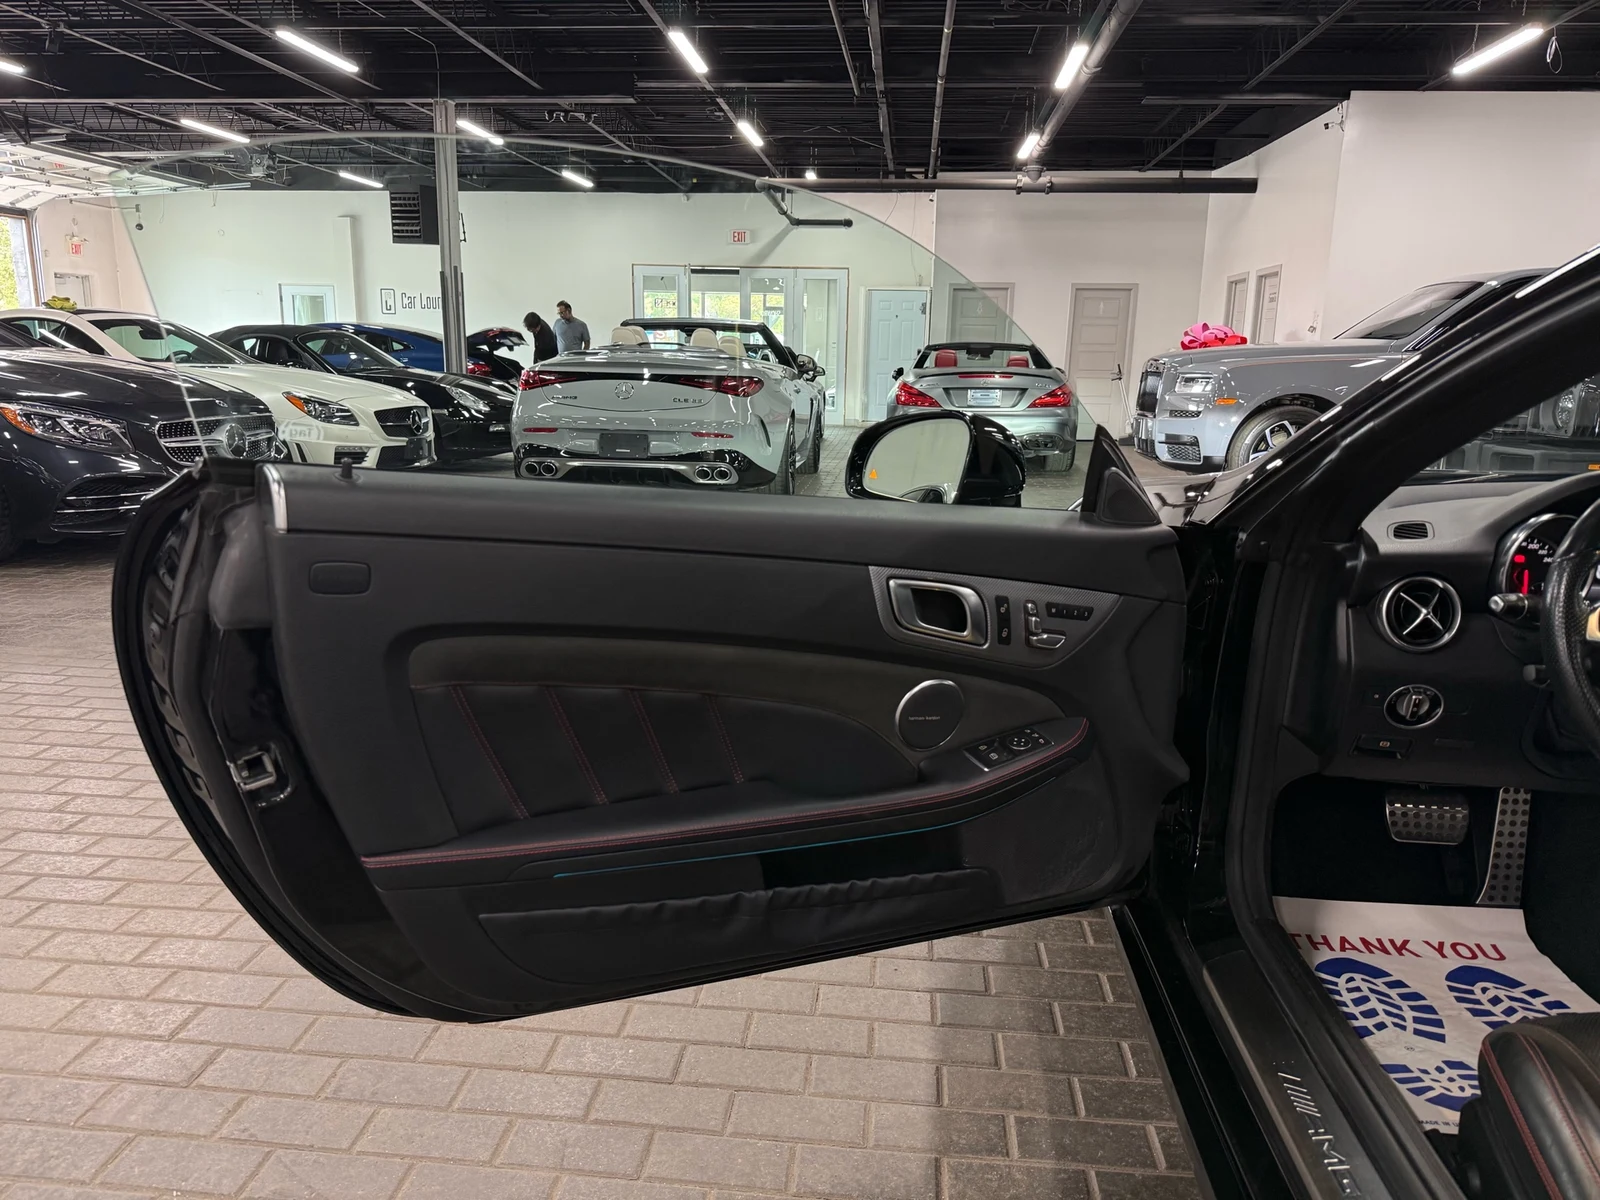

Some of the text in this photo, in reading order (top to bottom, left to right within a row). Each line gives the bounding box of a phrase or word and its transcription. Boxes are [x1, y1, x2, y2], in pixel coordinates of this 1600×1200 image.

[732, 231, 746, 243] EXIT
[401, 292, 416, 309] Car
[1288, 932, 1507, 962] THANK YOU
